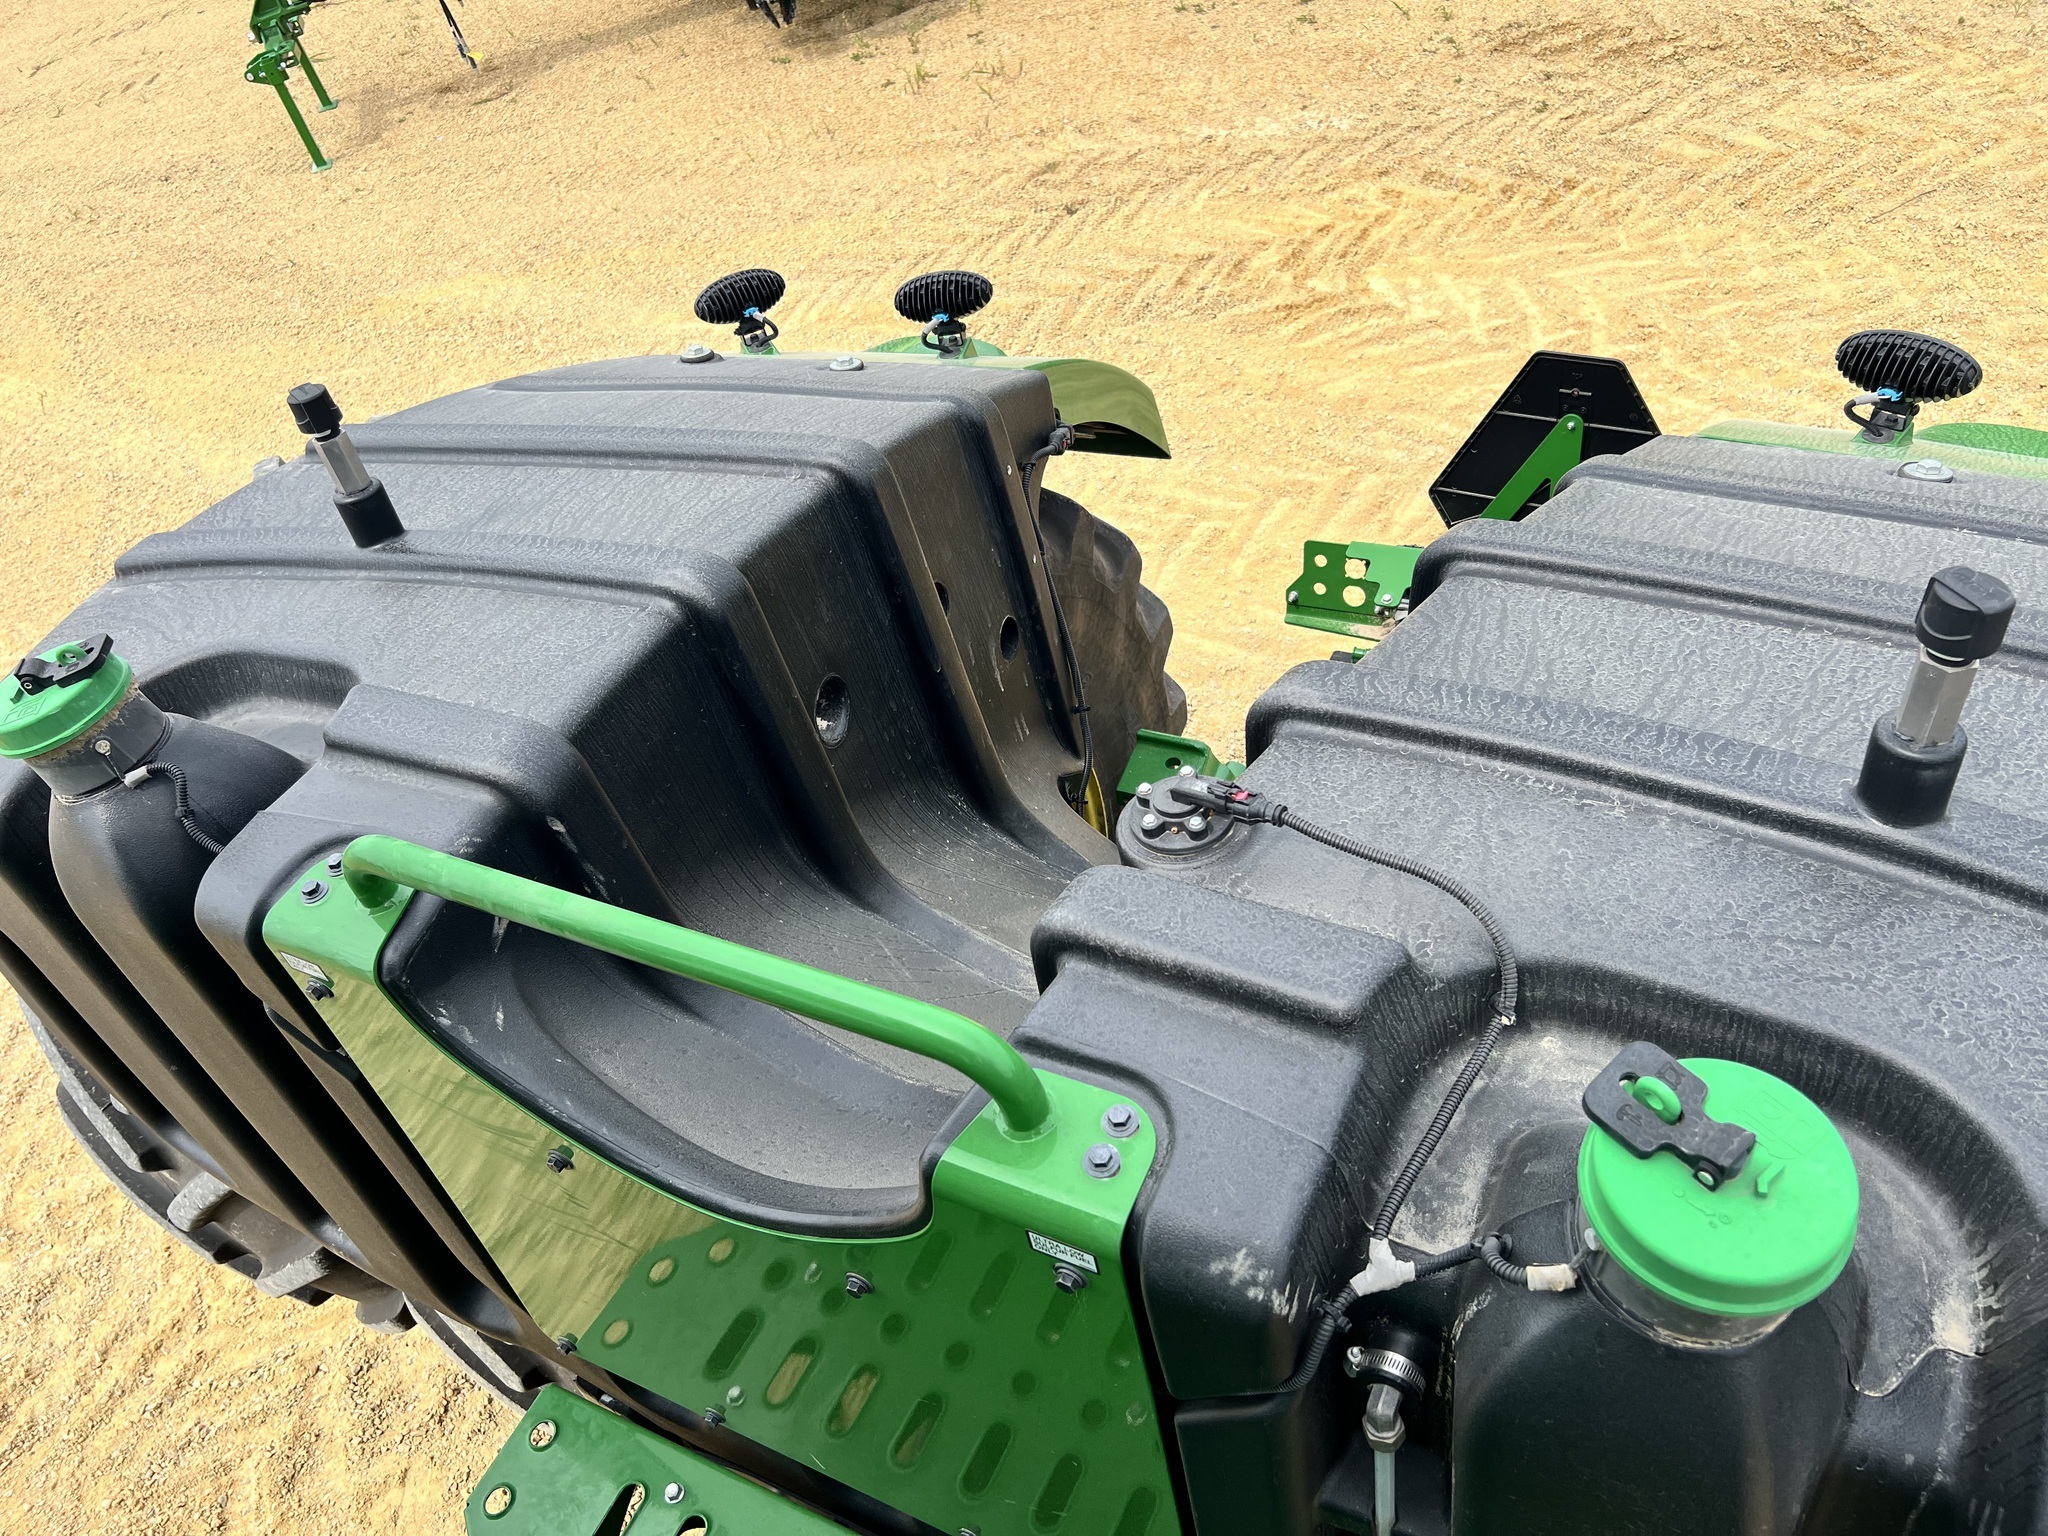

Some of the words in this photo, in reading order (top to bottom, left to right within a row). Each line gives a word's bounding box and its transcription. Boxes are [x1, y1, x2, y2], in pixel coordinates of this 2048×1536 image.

[1031, 1234, 1061, 1249] ULTRA
[1063, 1246, 1085, 1257] LOW
[1035, 1243, 1058, 1255] ONLY
[1069, 1252, 1093, 1266] FUEL
